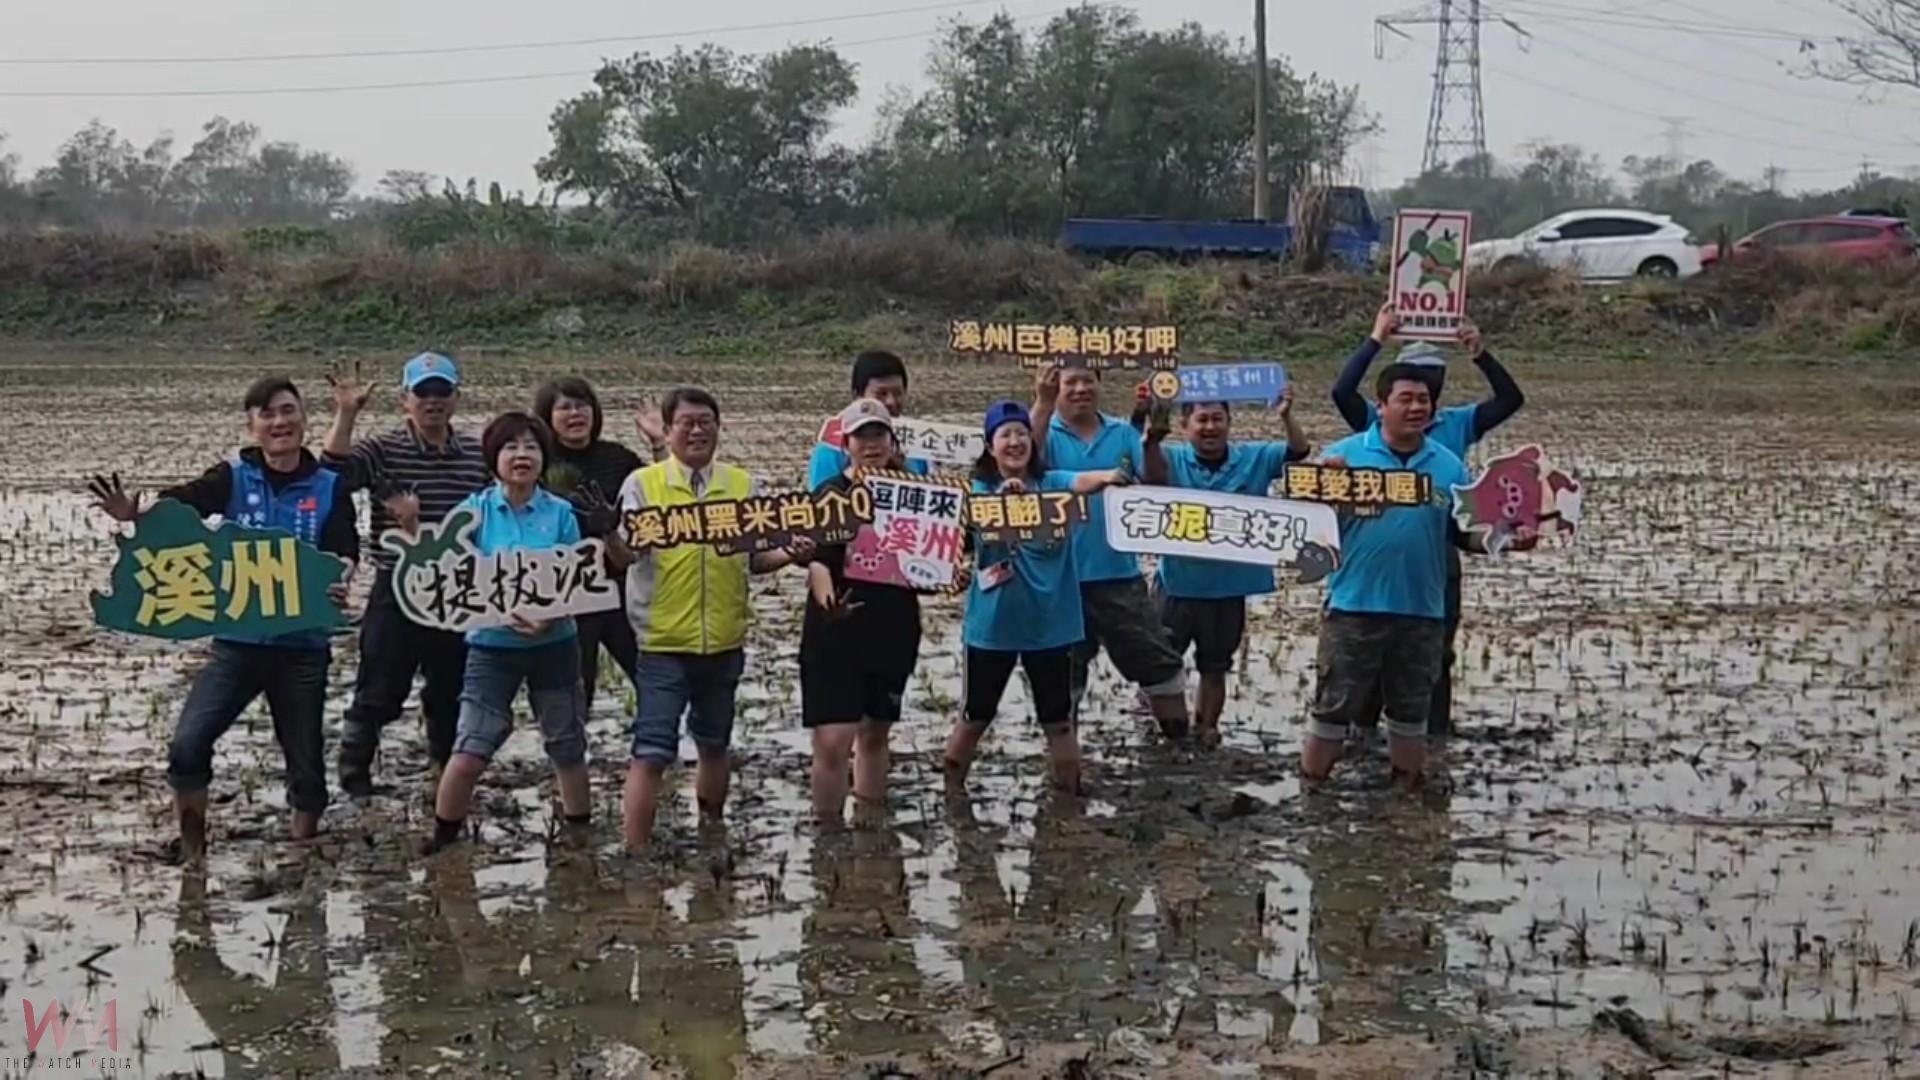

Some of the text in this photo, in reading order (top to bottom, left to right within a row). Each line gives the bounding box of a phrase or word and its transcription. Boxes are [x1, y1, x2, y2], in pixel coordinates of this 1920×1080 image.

[1399, 291, 1456, 312] NO.1
[951, 320, 1177, 354] 溪州芭樂尚好呷
[868, 480, 959, 518] 逗陣來
[1287, 466, 1430, 504] 要愛我喔!
[628, 487, 872, 547] 溪州黑米尚介Q
[879, 513, 960, 563] 溪州
[1120, 498, 1307, 551] 有泥真好!
[132, 536, 302, 627] 溪州
[423, 543, 609, 625] 提拔泥
